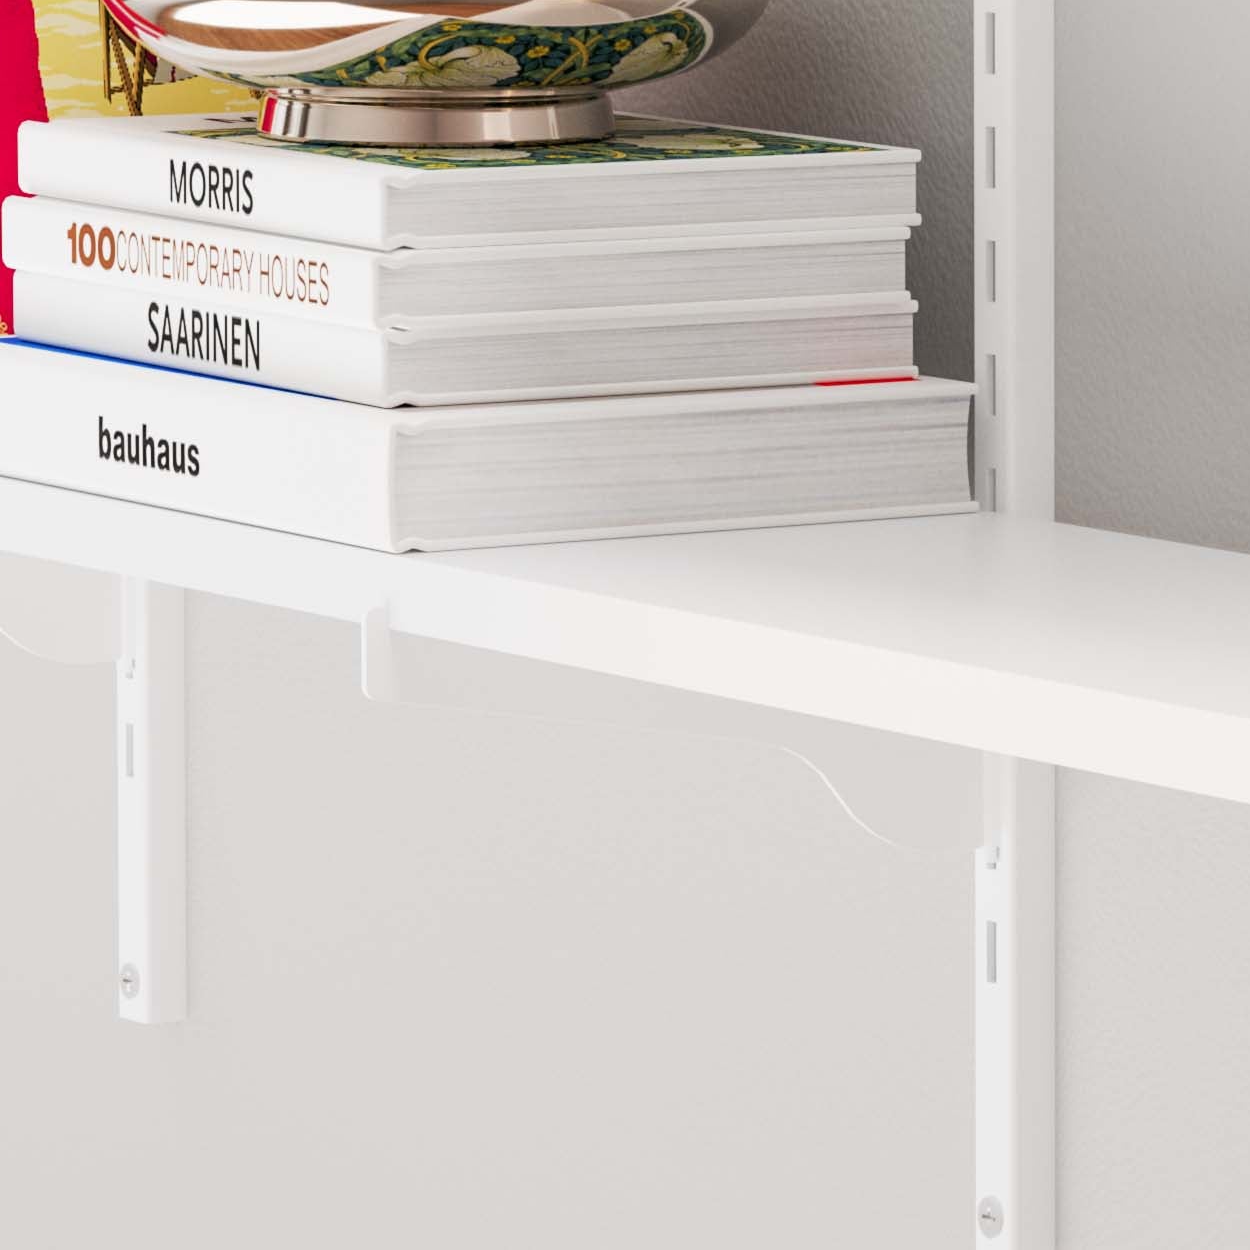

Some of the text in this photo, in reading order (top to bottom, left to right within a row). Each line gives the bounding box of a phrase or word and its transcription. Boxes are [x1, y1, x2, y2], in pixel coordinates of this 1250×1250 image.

[170, 159, 253, 214] MORRIS
[260, 252, 330, 306] HOUSES
[148, 302, 260, 370] SAARINEN
[99, 416, 200, 476] bauhaus
